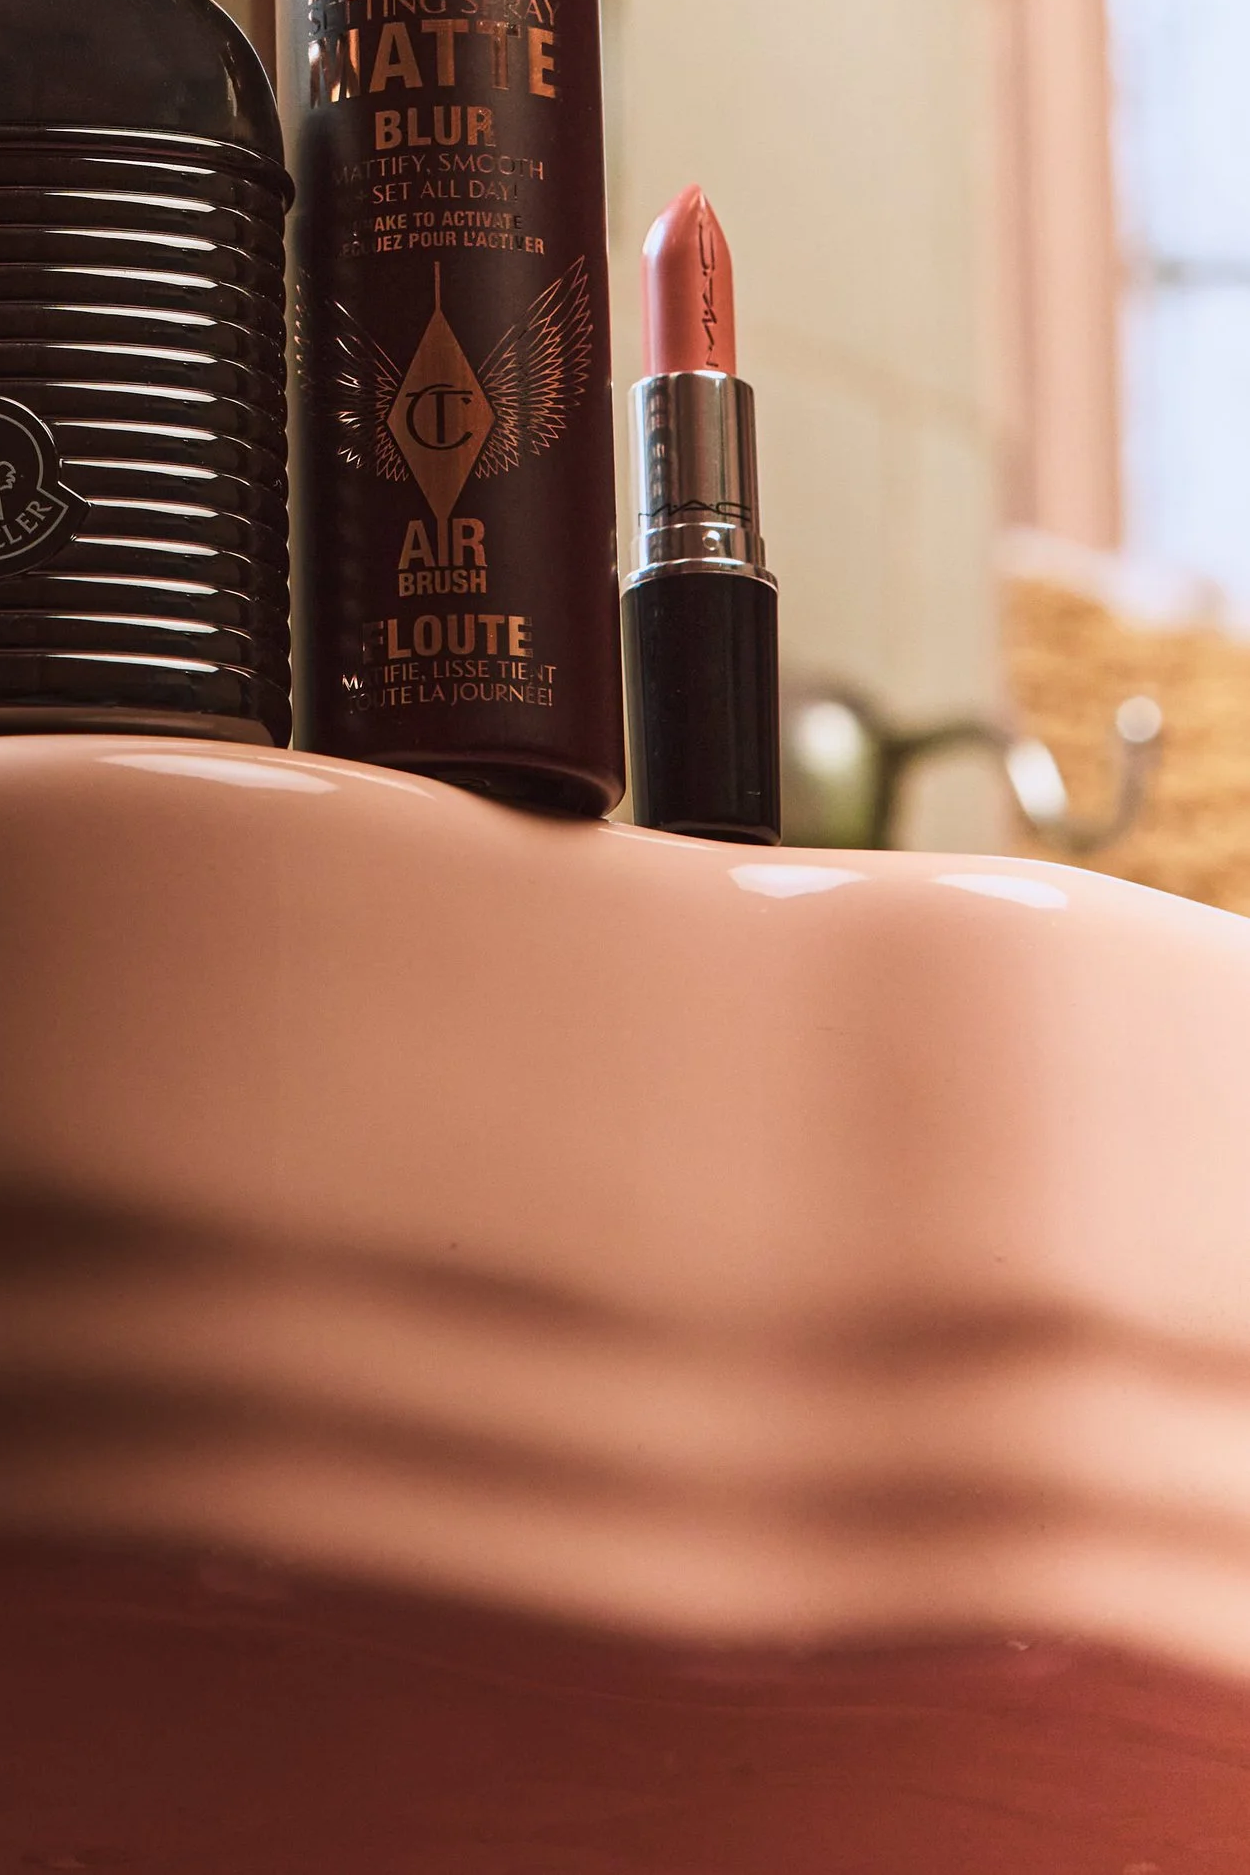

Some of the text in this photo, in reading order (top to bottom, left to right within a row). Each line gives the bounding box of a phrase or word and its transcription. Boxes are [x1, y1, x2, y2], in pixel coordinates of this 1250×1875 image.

[307, 18, 557, 109] MATTE
[375, 105, 497, 151] BLUR
[372, 180, 519, 205] SET ALL DAY!
[414, 212, 436, 229] TO
[442, 210, 523, 231] ACTIVATE
[409, 230, 457, 250] POUR
[398, 517, 488, 571] AIR
[399, 568, 488, 598] BRUSH
[361, 613, 534, 665] FLOUTE
[433, 659, 491, 680] LISSE
[419, 683, 446, 704] LA
[451, 681, 554, 708] JOURNÉE!
